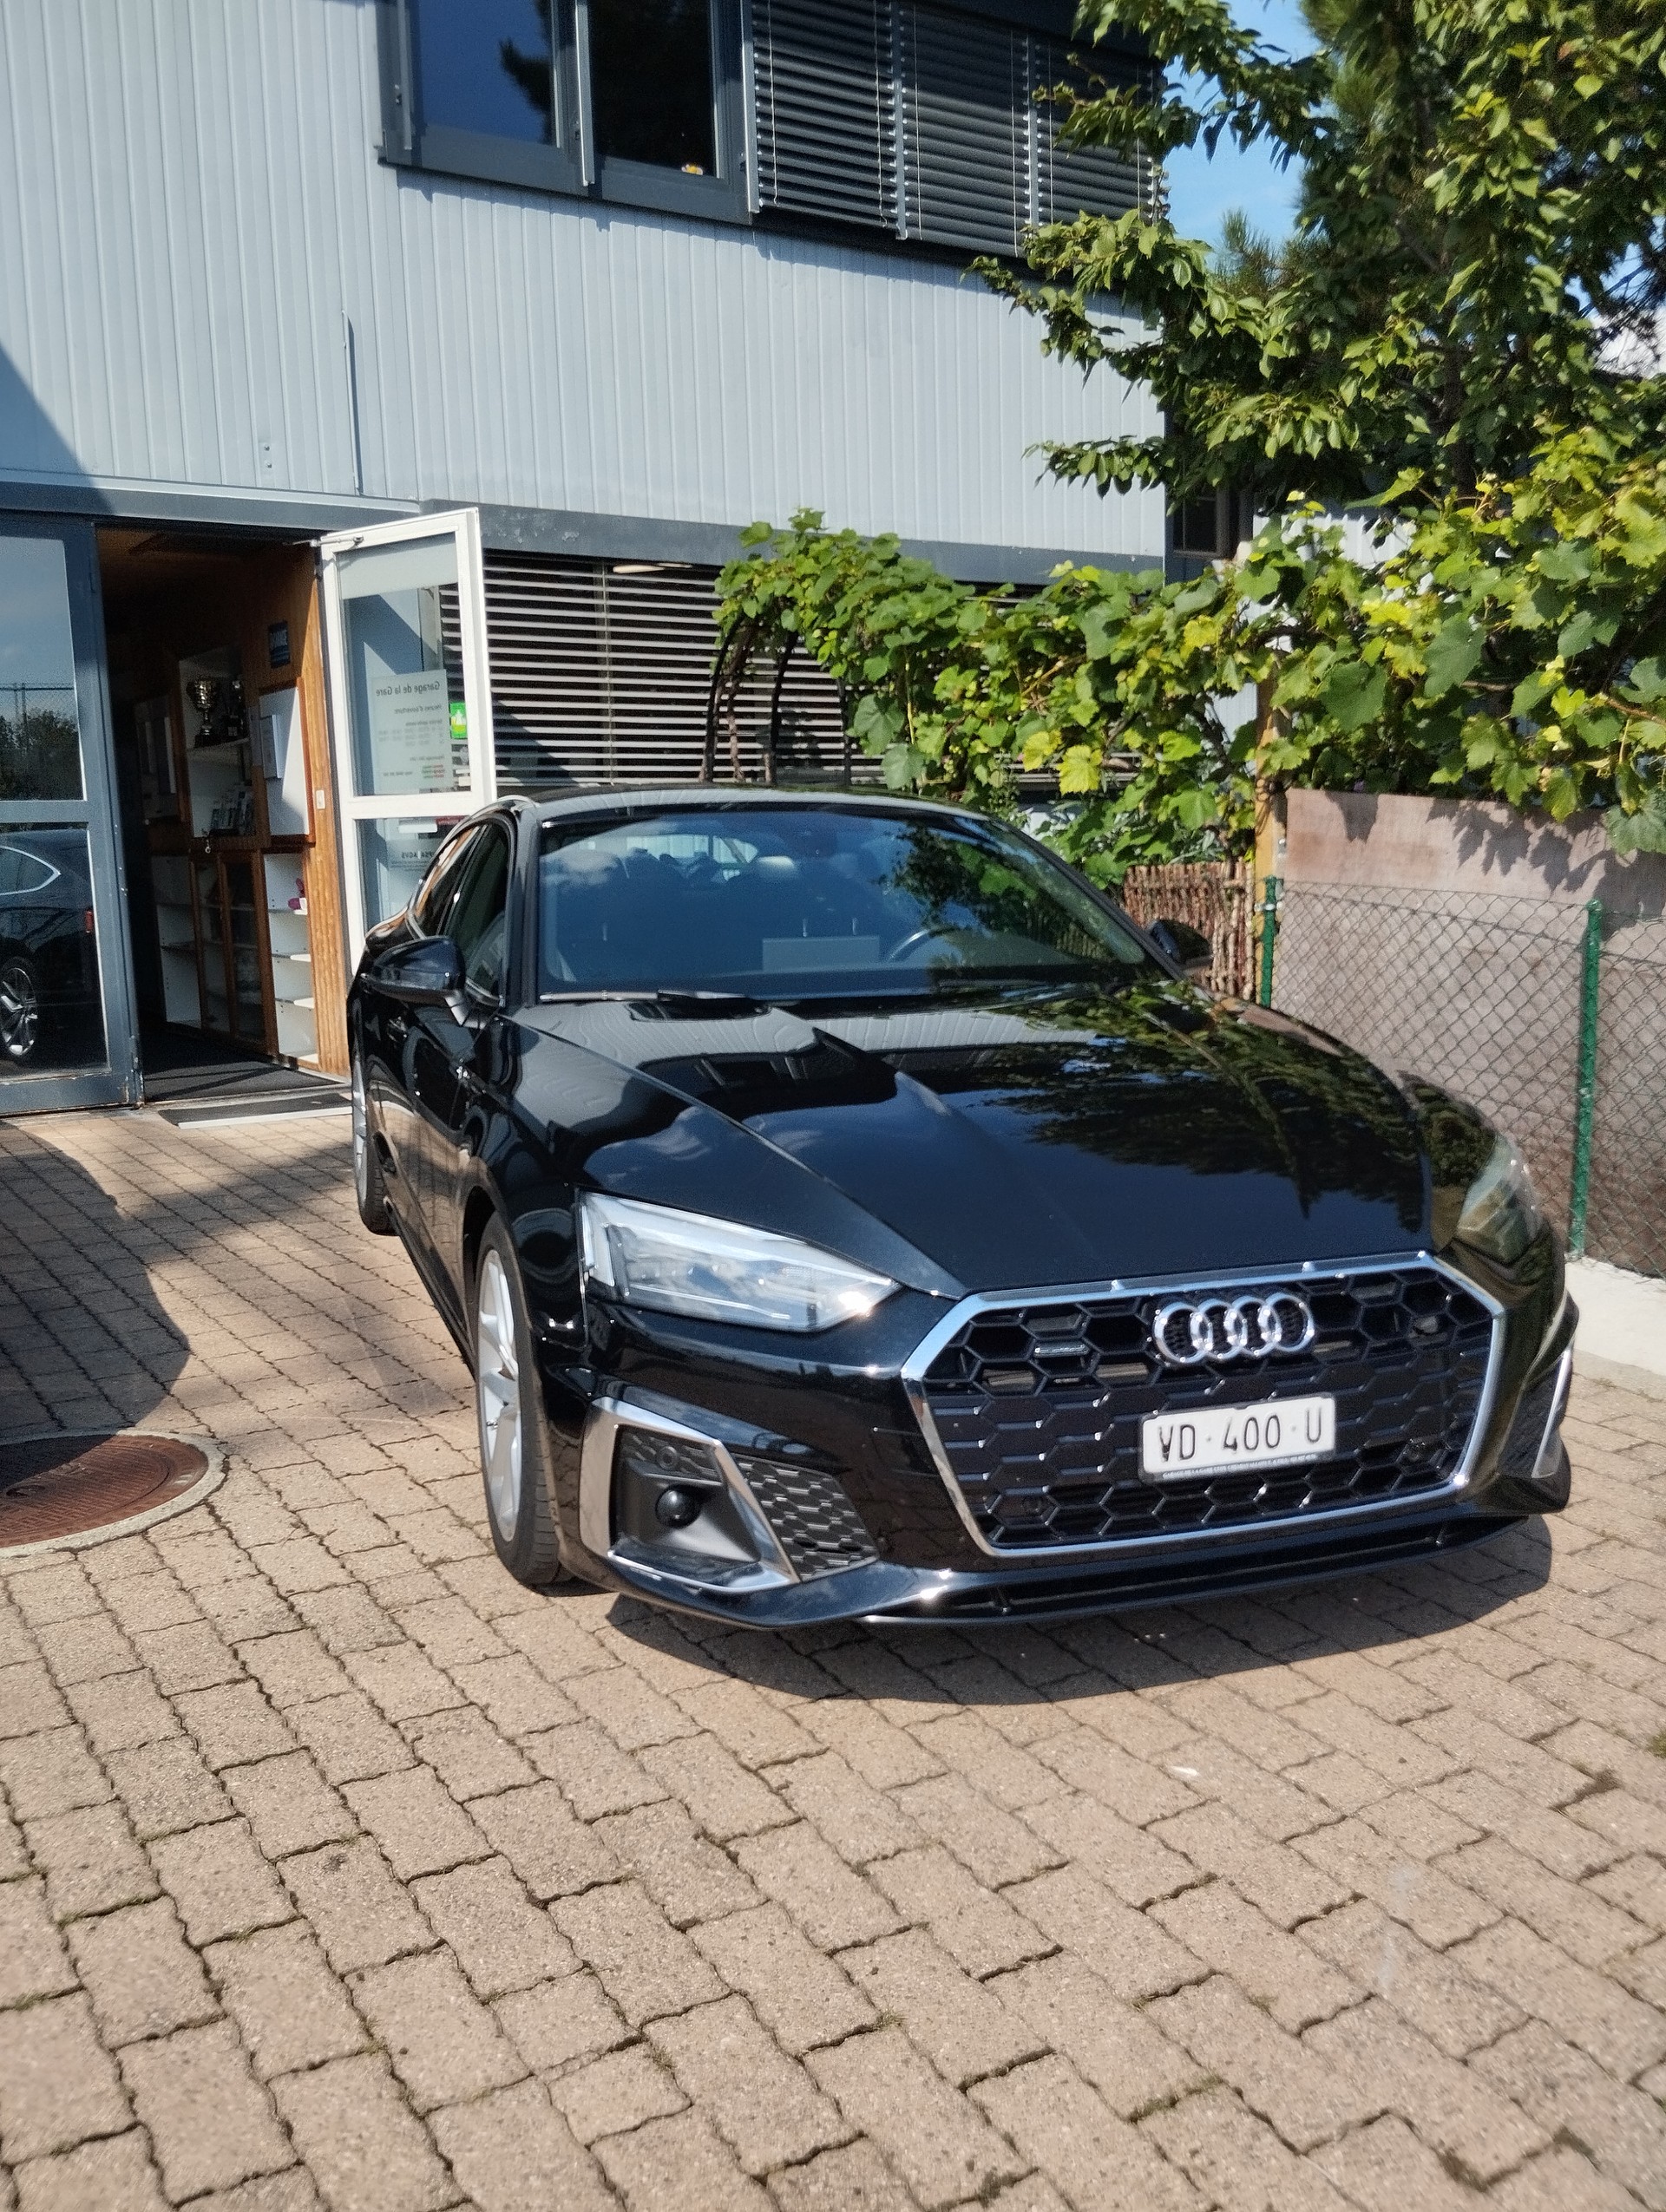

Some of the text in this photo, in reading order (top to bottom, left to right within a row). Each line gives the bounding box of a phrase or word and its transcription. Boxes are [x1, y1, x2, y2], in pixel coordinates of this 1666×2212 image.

[1158, 1406, 1322, 1463] VD 400 U
